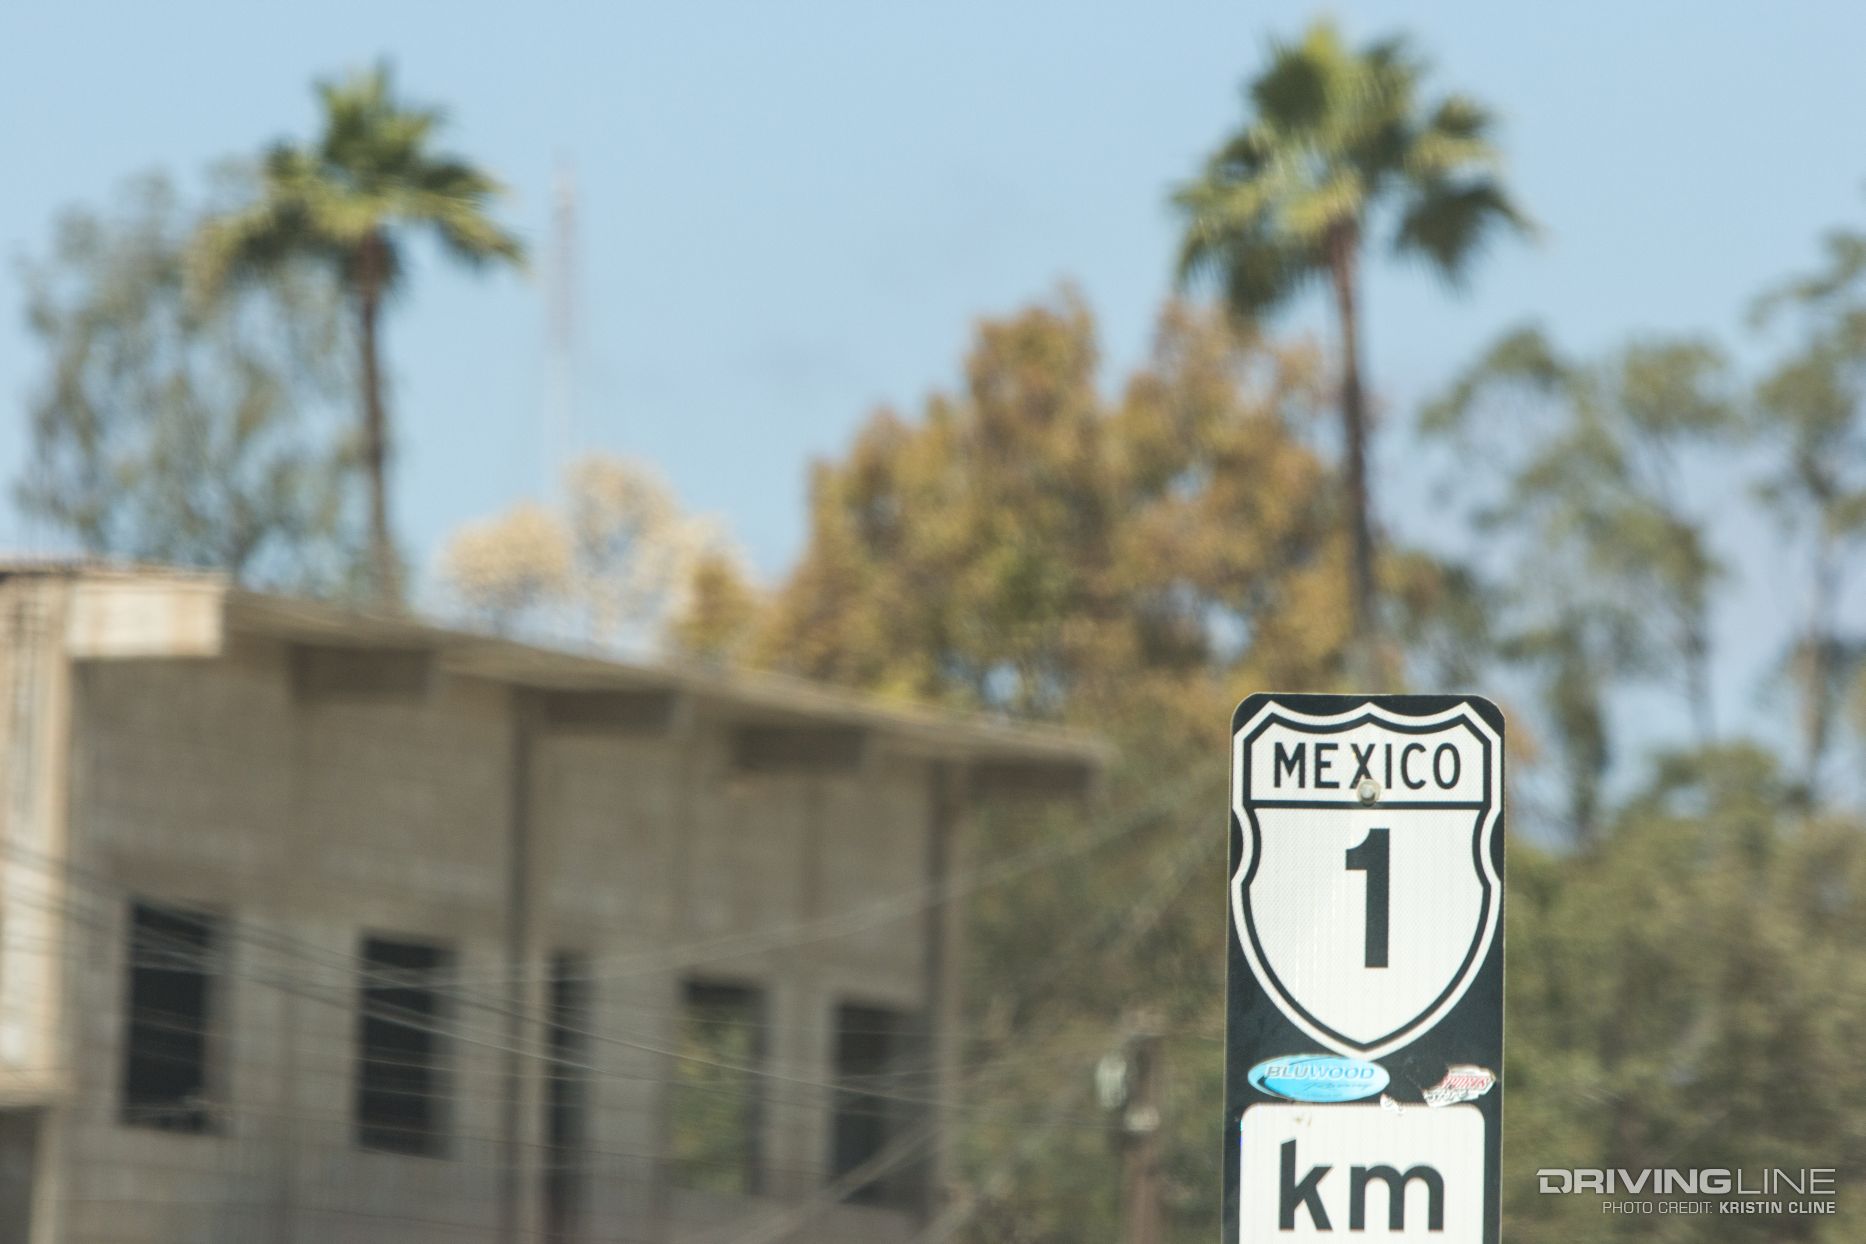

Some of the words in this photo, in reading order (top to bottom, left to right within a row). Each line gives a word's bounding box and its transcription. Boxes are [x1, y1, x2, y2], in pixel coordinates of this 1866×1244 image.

[1273, 742, 1461, 790] MEXICO
[1345, 828, 1390, 968] 1
[1266, 1065, 1375, 1080] BLUWOOD
[1279, 1139, 1444, 1231] km
